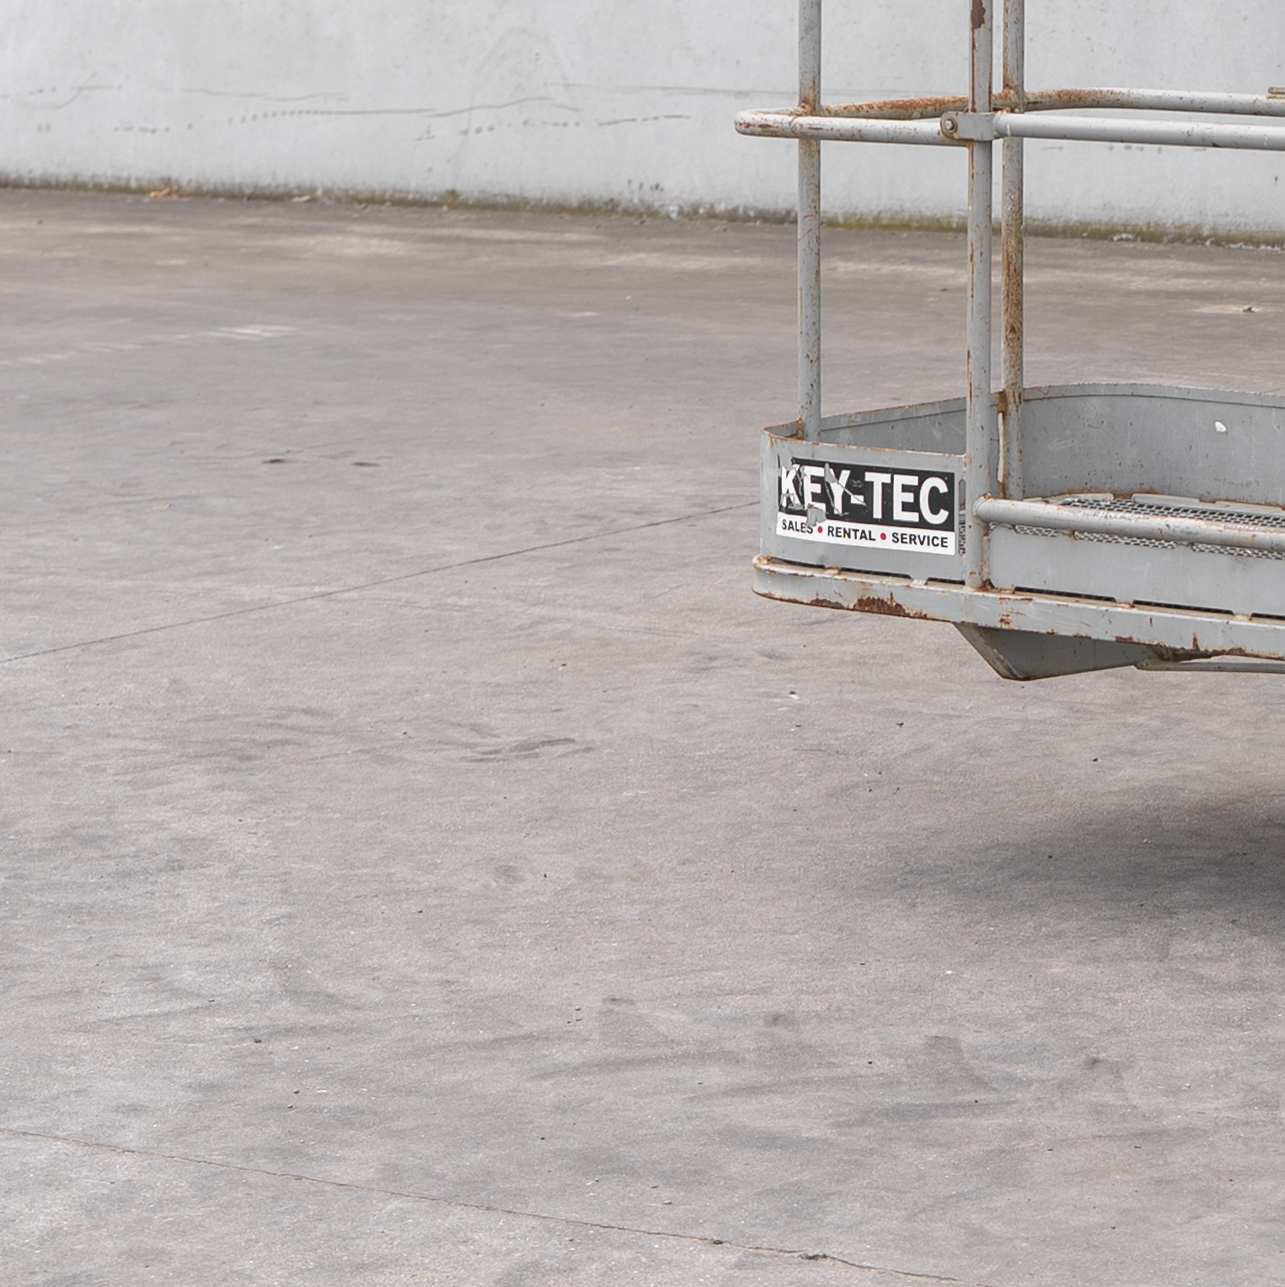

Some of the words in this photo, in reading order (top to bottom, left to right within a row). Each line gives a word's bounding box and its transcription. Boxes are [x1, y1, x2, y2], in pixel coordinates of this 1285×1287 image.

[781, 463, 949, 525] KEY-TEC
[782, 519, 814, 534] SALES
[827, 525, 876, 542] RENTAL
[892, 532, 949, 548] SERVICE
